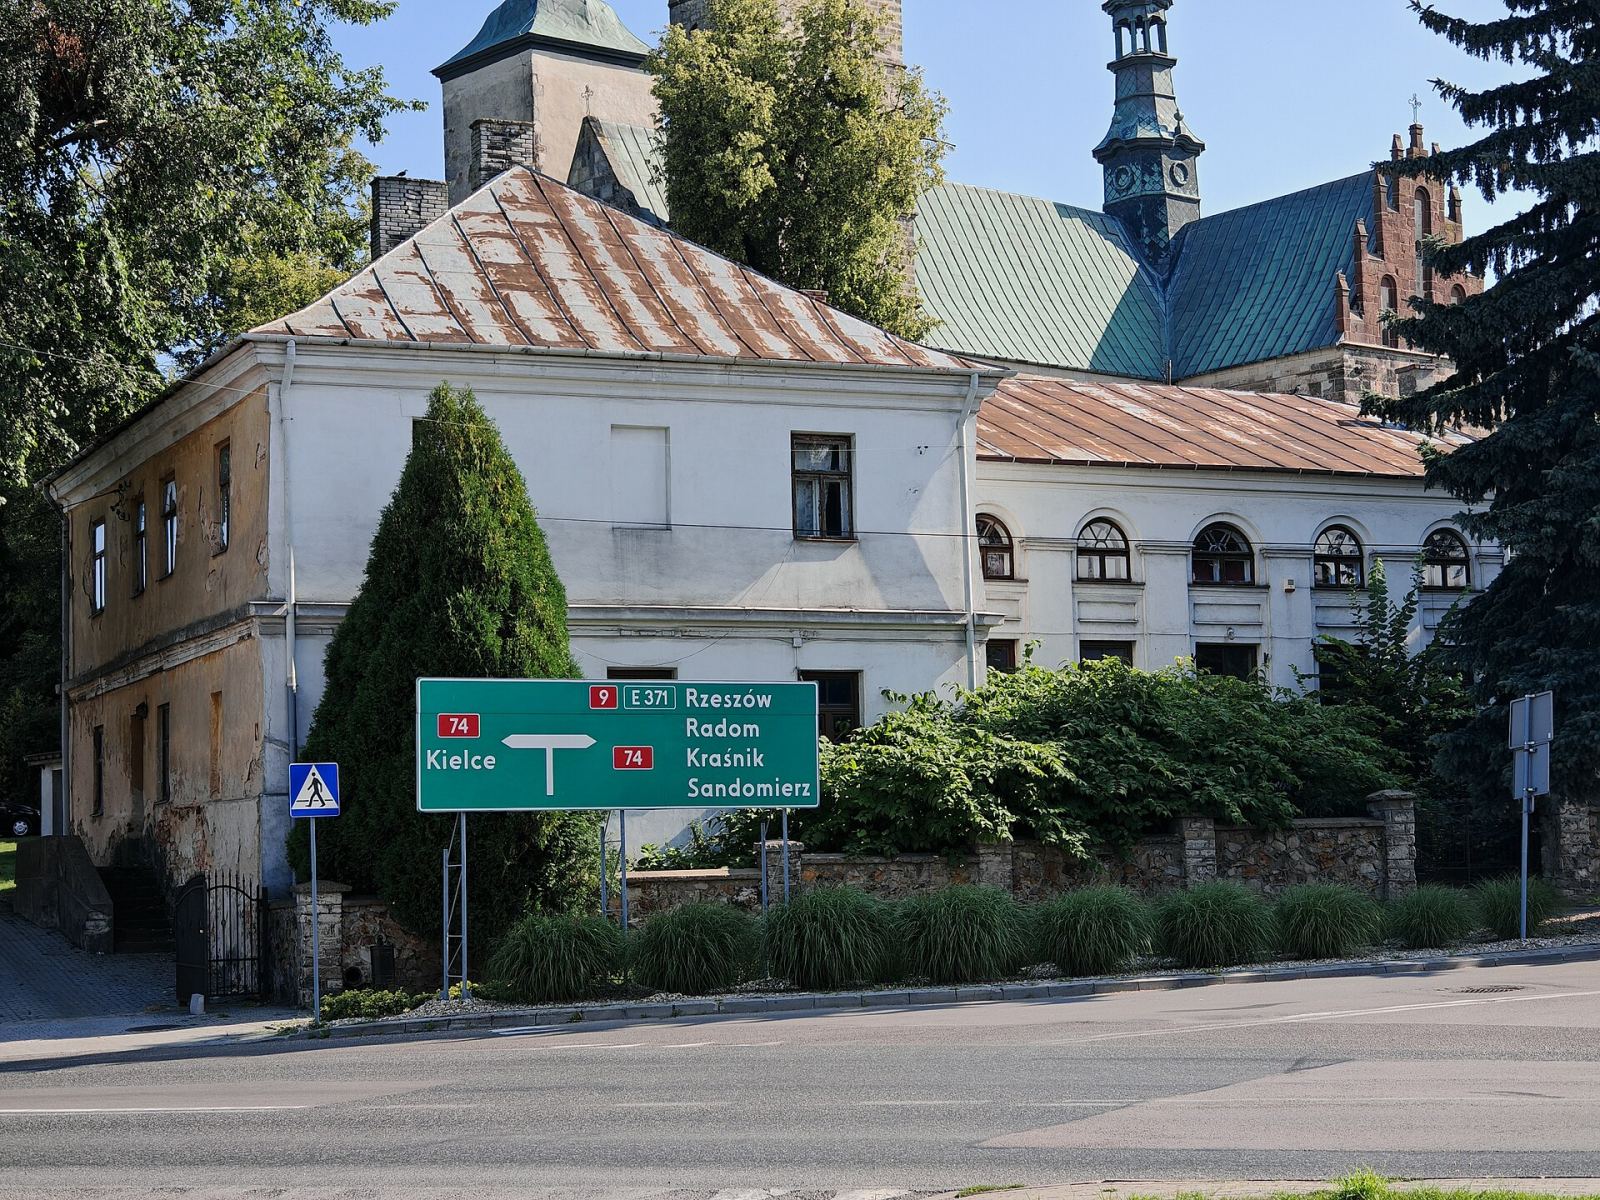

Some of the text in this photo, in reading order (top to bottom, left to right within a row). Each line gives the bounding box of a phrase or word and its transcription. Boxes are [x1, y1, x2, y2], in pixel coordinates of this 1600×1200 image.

[599, 689, 608, 705] 9
[631, 690, 668, 706] E 371
[686, 688, 772, 708] Rzeszów
[449, 717, 469, 734] 74
[686, 718, 760, 737] Radom
[426, 749, 496, 770] Kielce
[624, 750, 643, 766] 74
[687, 747, 764, 767] Kraśnik
[687, 777, 811, 798] Sandomierz
